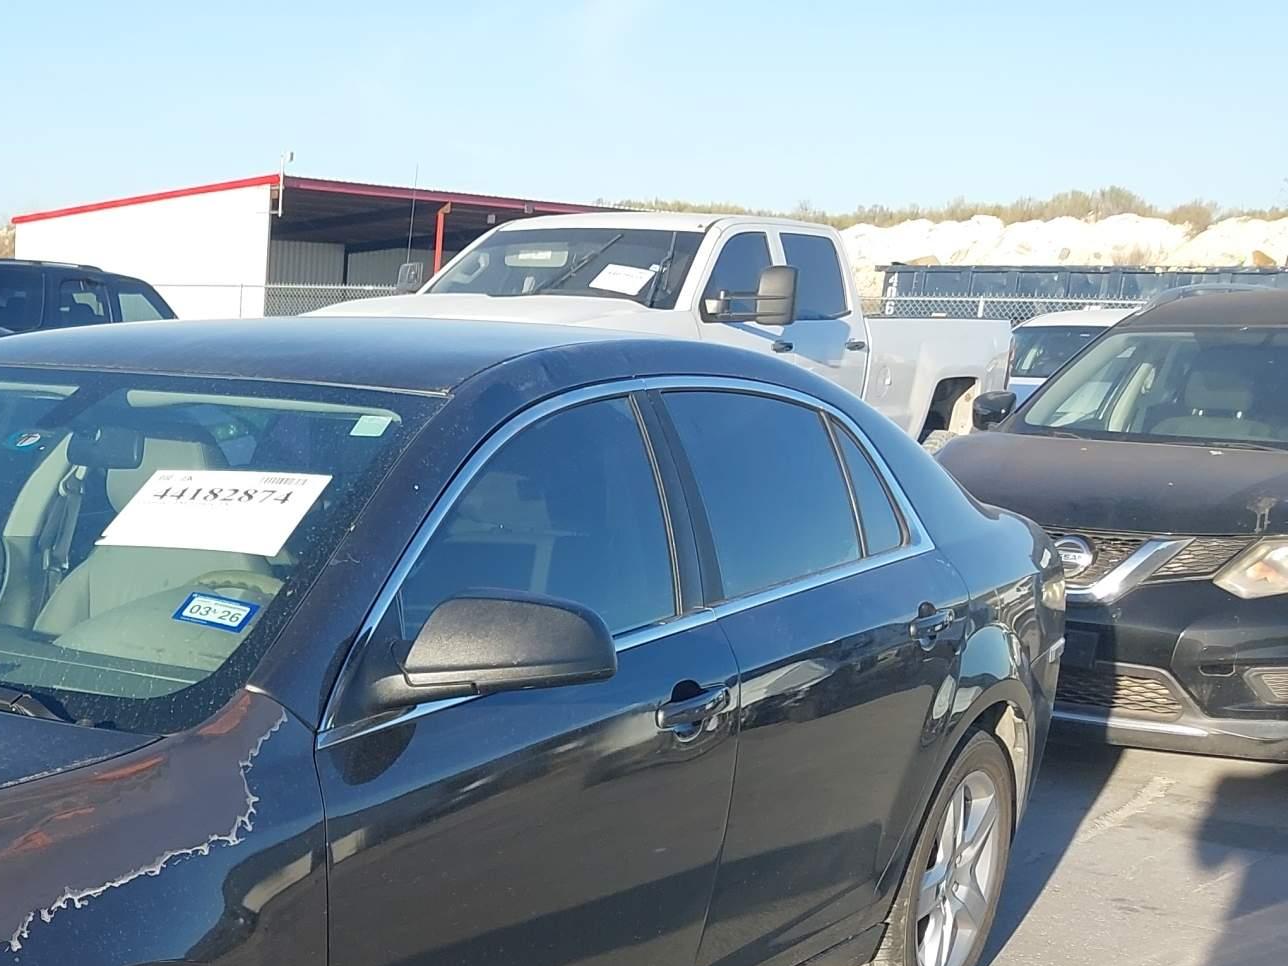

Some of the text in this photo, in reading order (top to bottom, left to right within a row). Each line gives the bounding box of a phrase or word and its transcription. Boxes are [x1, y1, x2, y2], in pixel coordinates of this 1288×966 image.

[153, 487, 293, 504] 44182874
[189, 604, 212, 616] 03
[218, 610, 242, 623] 26
